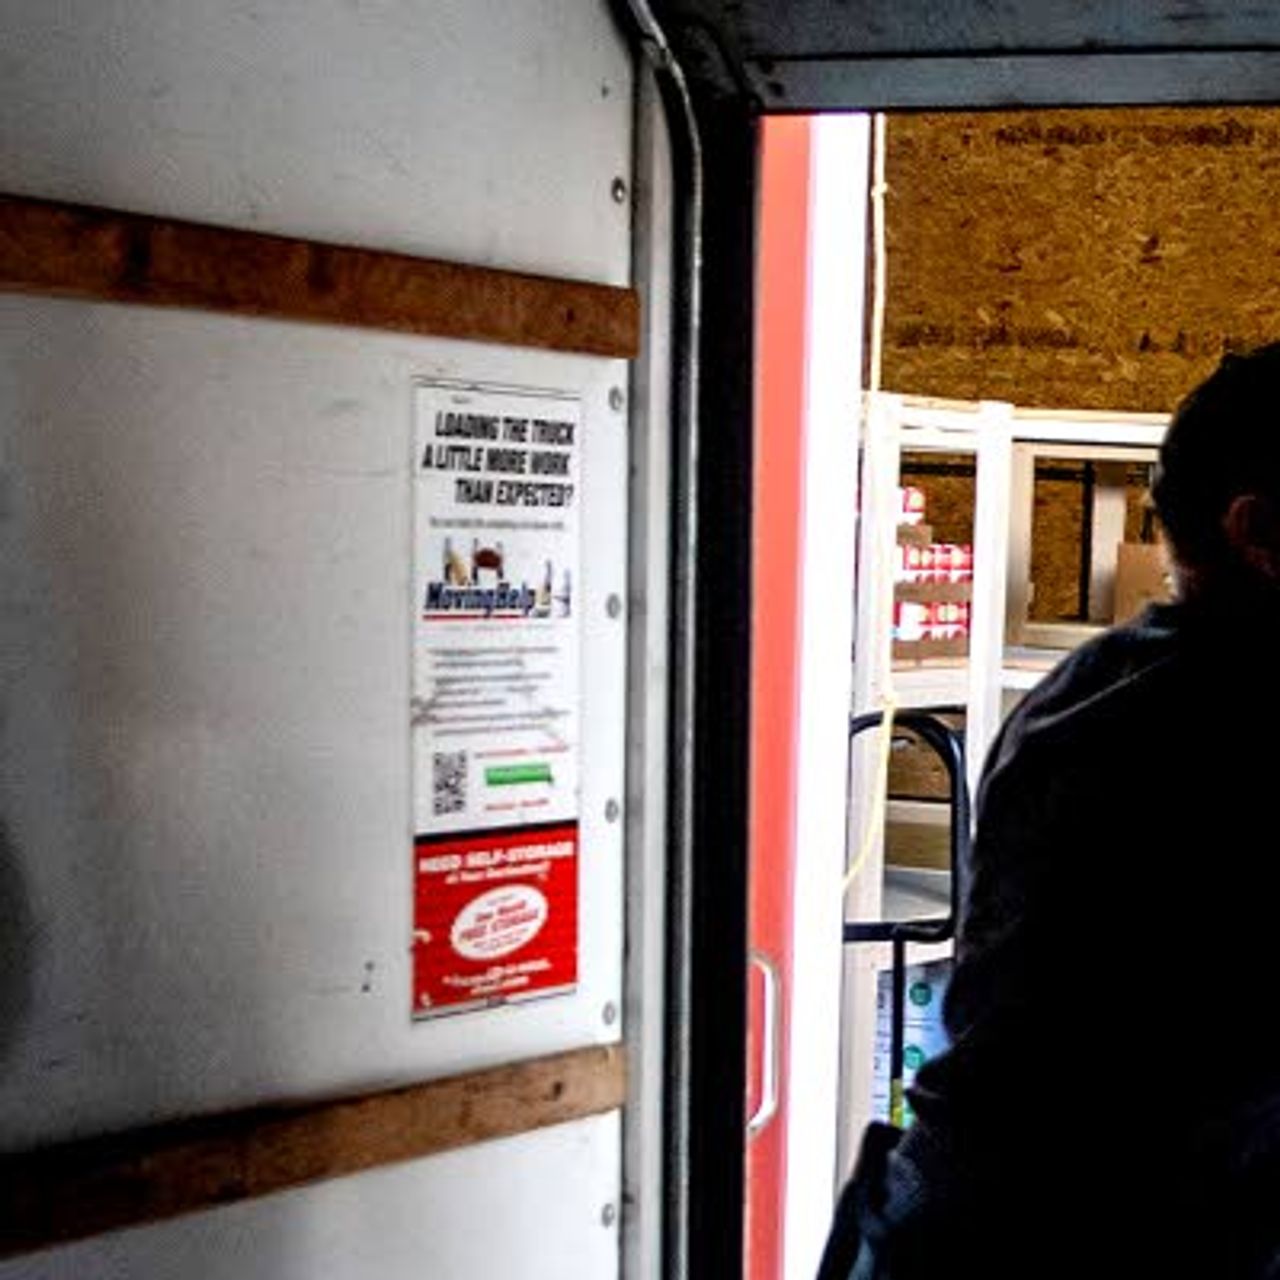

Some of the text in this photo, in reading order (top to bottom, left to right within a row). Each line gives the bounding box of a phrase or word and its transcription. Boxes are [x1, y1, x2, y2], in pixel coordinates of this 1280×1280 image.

[435, 411, 575, 445] LOADING THE TRUCK
[422, 444, 571, 474] A LITTLE MORE WORK
[454, 479, 574, 506] THAN EXPECTED?
[423, 581, 536, 619] MovingHelp
